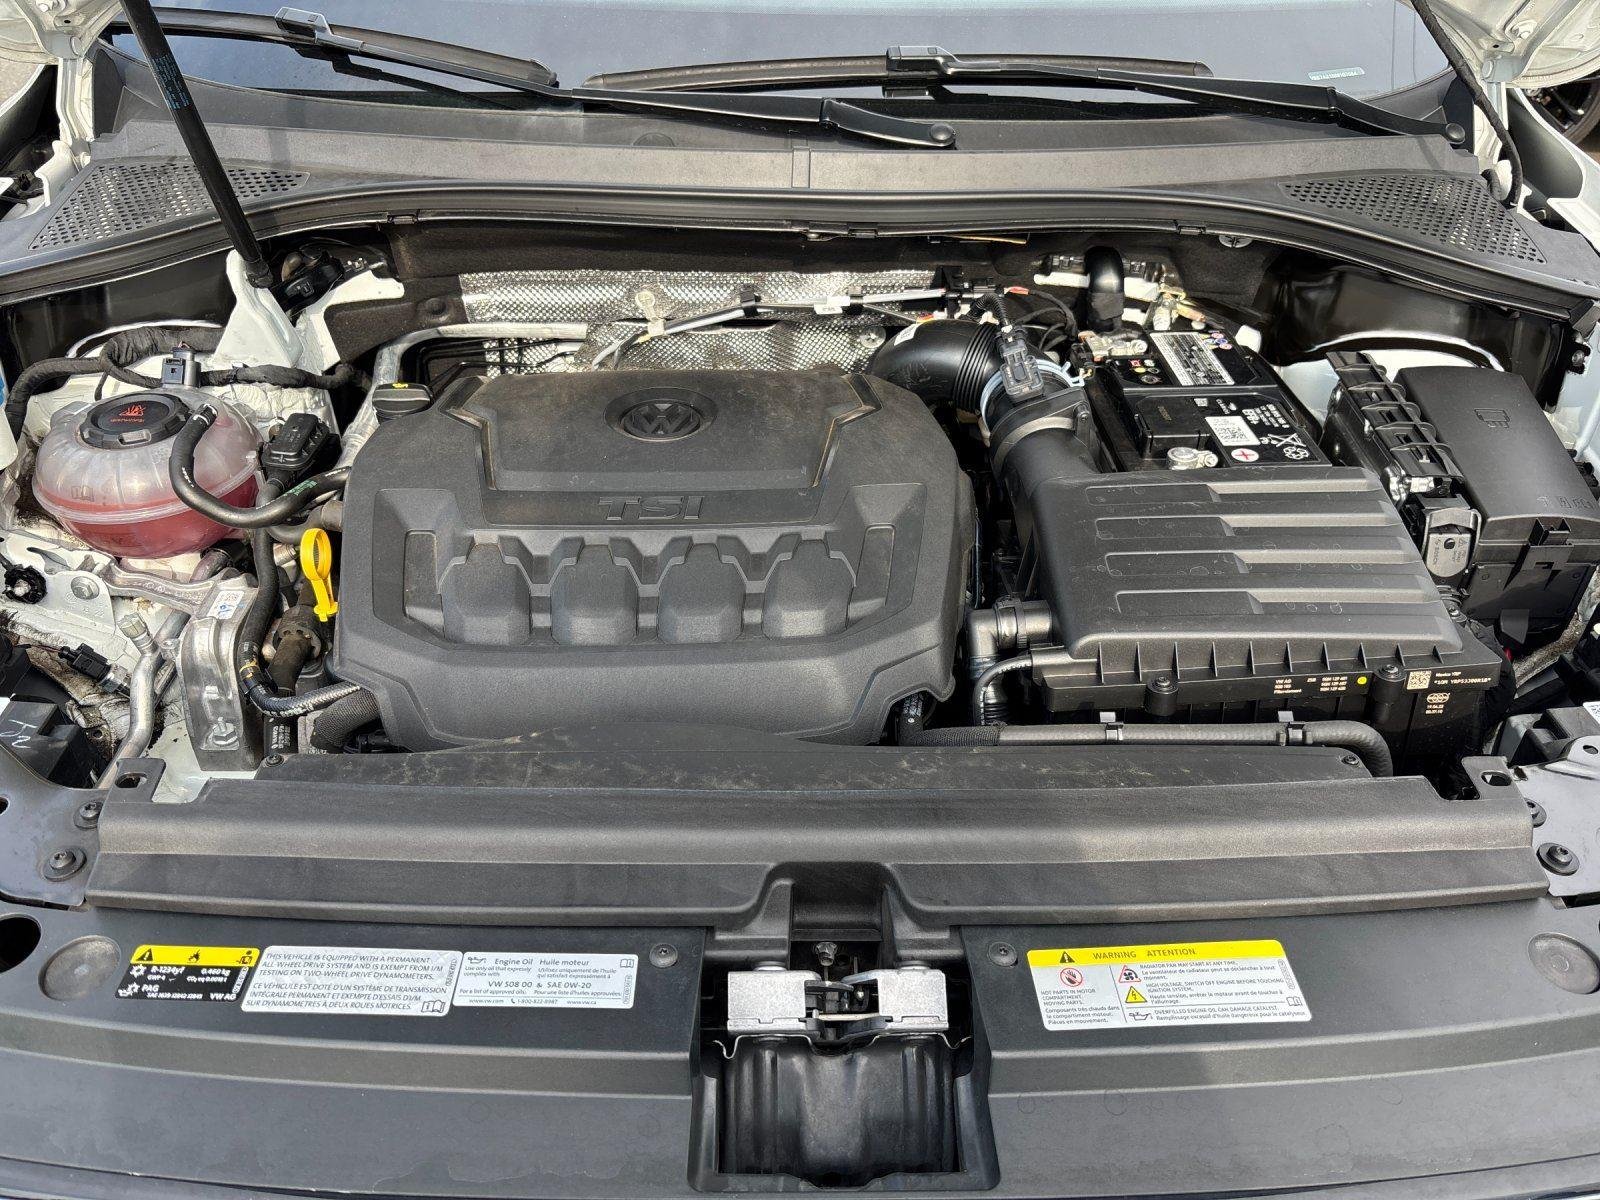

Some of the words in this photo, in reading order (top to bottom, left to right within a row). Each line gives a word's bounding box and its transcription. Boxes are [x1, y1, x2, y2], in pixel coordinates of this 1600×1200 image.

[599, 496, 704, 520] TSI
[1093, 951, 1136, 959] WARNING
[1147, 948, 1196, 957] ATTENTION
[495, 958, 520, 966] Engine
[141, 984, 160, 992] PAG
[264, 982, 298, 990] VÉHICULE
[312, 982, 332, 990] DOTÉ
